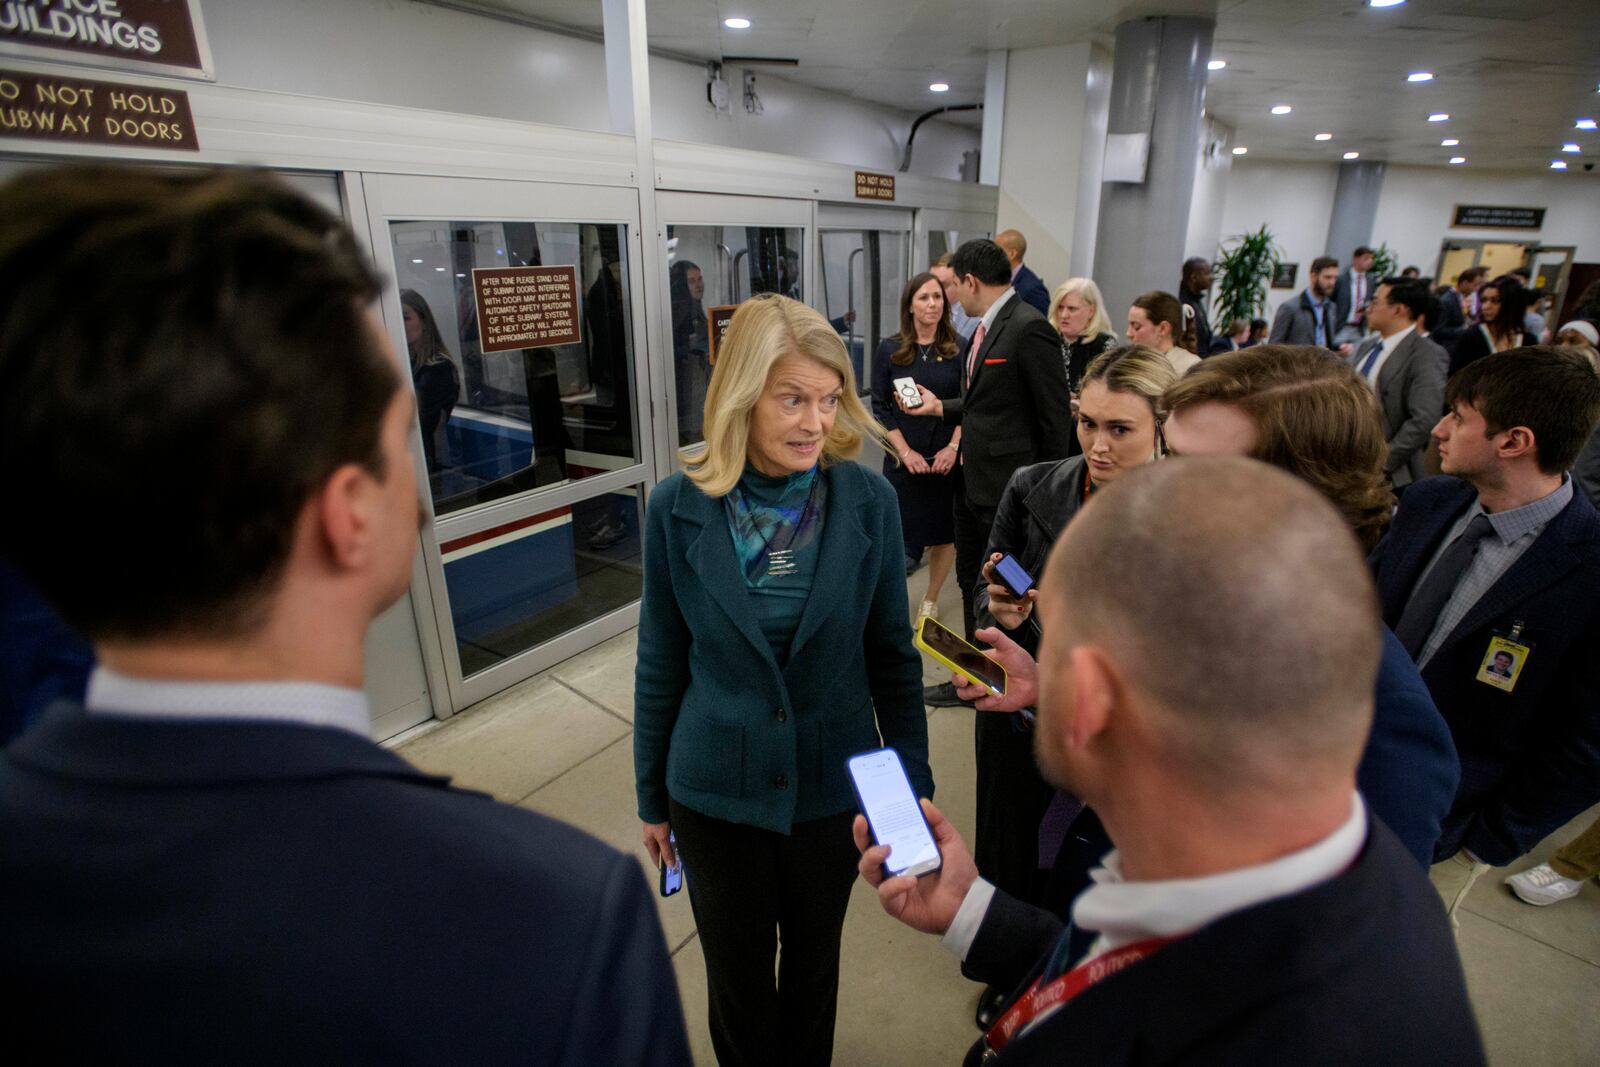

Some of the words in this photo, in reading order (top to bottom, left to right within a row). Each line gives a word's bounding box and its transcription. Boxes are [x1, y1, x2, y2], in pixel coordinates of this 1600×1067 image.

[0, 3, 161, 52] UILDINGS
[0, 80, 19, 99] O
[35, 84, 94, 107] NOT
[109, 92, 176, 115] HOLD
[0, 107, 91, 134] UBWAY
[105, 117, 183, 141] DOORS
[857, 174, 866, 184] DO
[867, 176, 879, 185] NOT
[879, 177, 893, 188] HOLD
[857, 186, 877, 195] SUBWAY
[878, 187, 893, 197] DOORS
[482, 277, 499, 285] AFTER
[501, 276, 515, 285] TONE
[516, 276, 535, 284] PLEASE
[537, 275, 551, 283] STAND
[553, 274, 569, 282] CLEAR
[483, 288, 491, 296] OF
[494, 286, 515, 295] SUBWAY
[538, 283, 570, 292] INTERFERING
[484, 297, 501, 305] WITH
[503, 296, 521, 304] DOOR
[538, 293, 560, 301] INITIATE
[486, 305, 518, 315] AUTOMATIC
[519, 303, 540, 312] SAFETY
[542, 301, 572, 310] SHUTDOWN
[489, 316, 499, 324] OF
[502, 315, 516, 323] THE
[517, 313, 542, 321] SUBWAY
[488, 326, 501, 334] THE
[503, 324, 519, 333] NEXT
[522, 322, 535, 330] CAR
[537, 320, 550, 329] WILL
[552, 318, 573, 327] ARRIVE
[488, 336, 495, 344] IN
[496, 332, 538, 343] APPROXIMATELY
